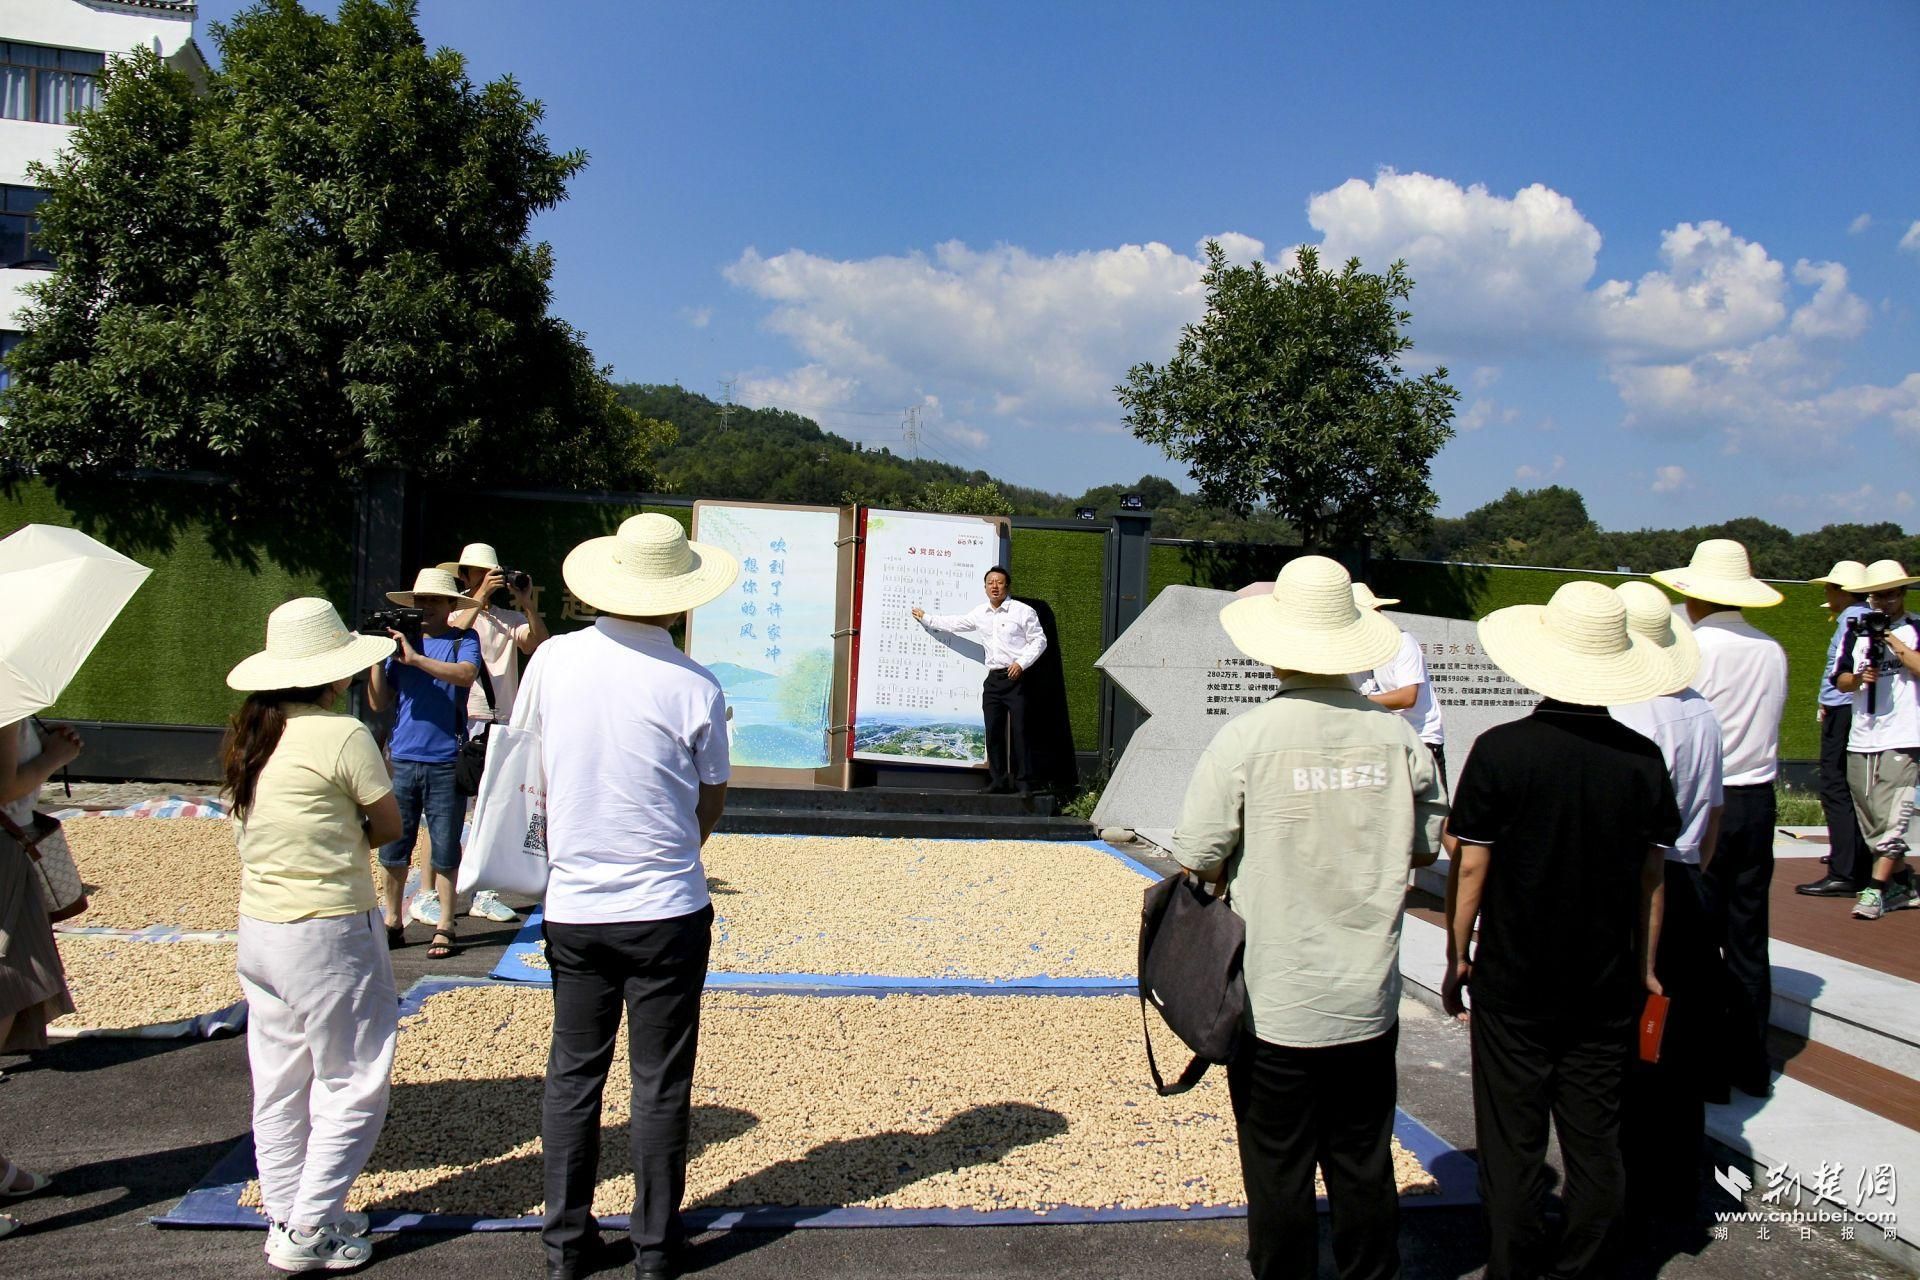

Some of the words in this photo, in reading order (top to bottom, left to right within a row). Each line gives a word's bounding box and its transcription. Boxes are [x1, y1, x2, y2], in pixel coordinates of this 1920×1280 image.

[919, 547, 953, 558] 党员公约
[739, 556, 760, 640] 想你的风
[764, 536, 788, 664] 吹到了许家冲
[1292, 762, 1388, 791] BREEZE
